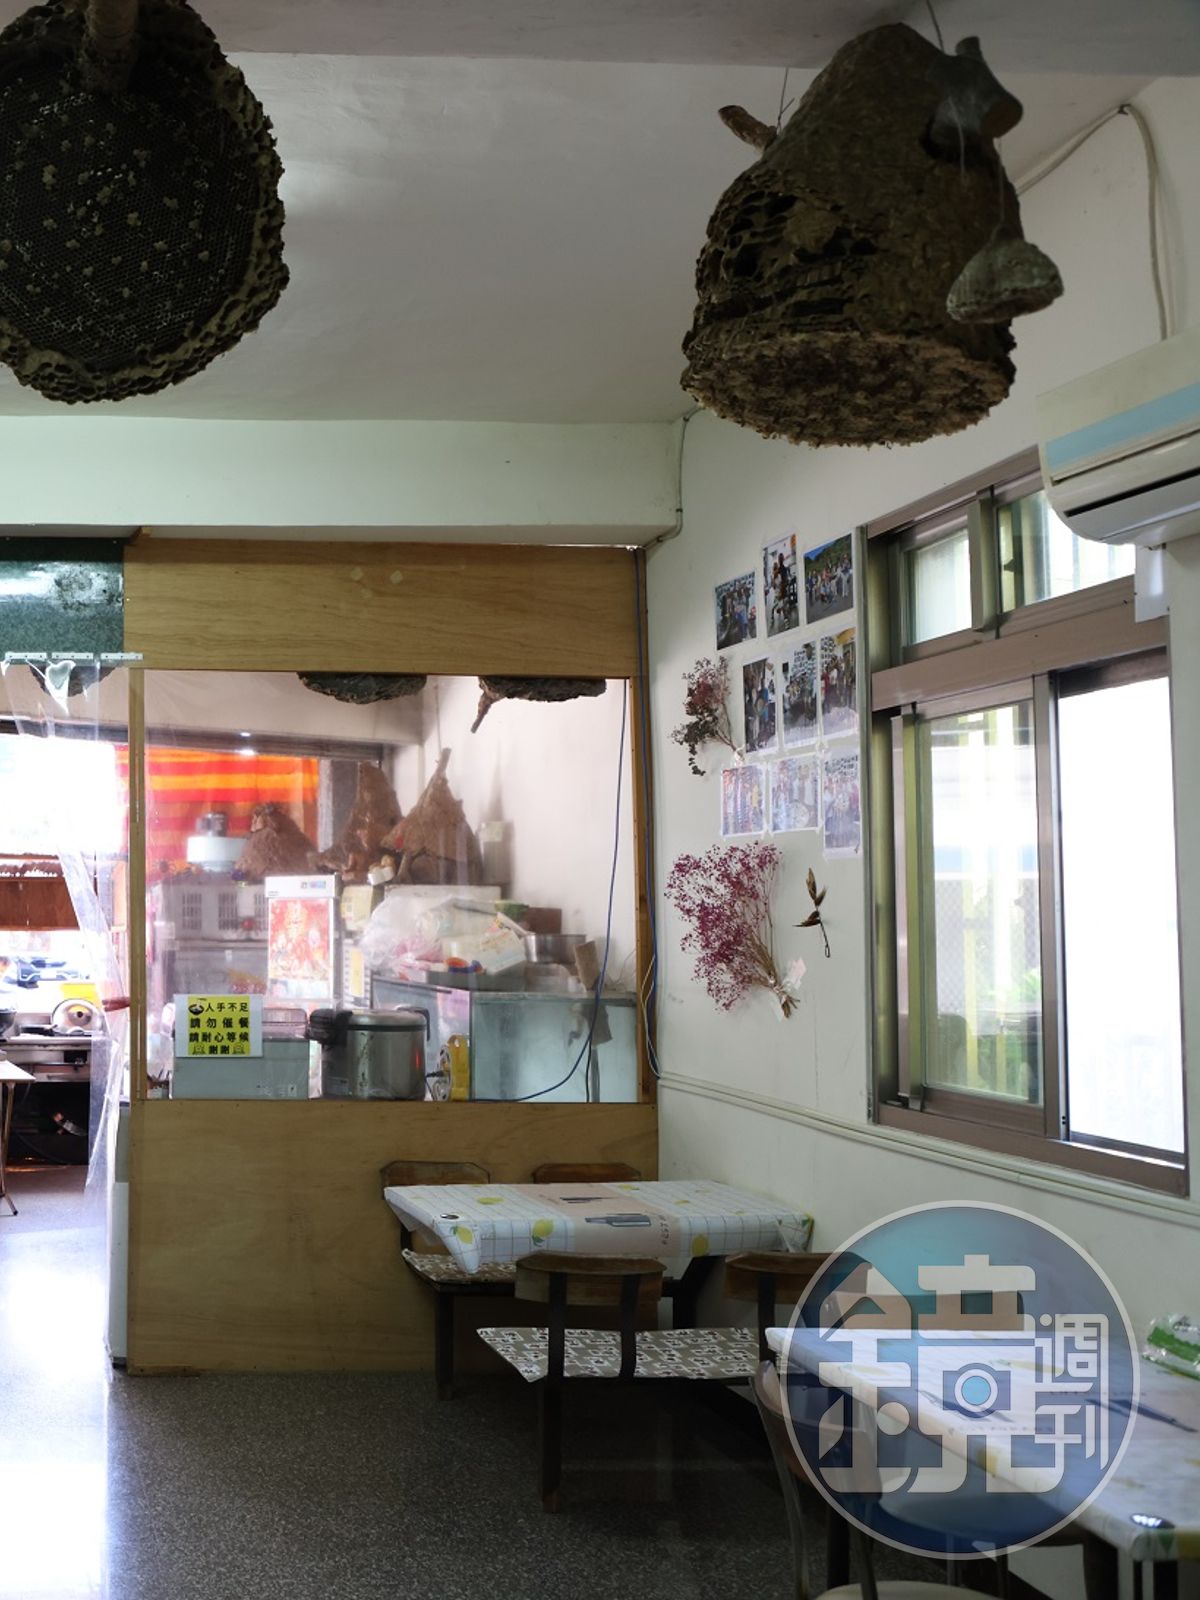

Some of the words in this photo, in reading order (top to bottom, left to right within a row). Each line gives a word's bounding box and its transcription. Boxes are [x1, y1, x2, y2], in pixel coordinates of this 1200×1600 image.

[205, 1002, 248, 1012] 人手不足
[190, 1017, 248, 1028] 請勿催餐
[189, 1031, 248, 1042] 請耐心等候
[208, 1045, 230, 1054] 謝謝
